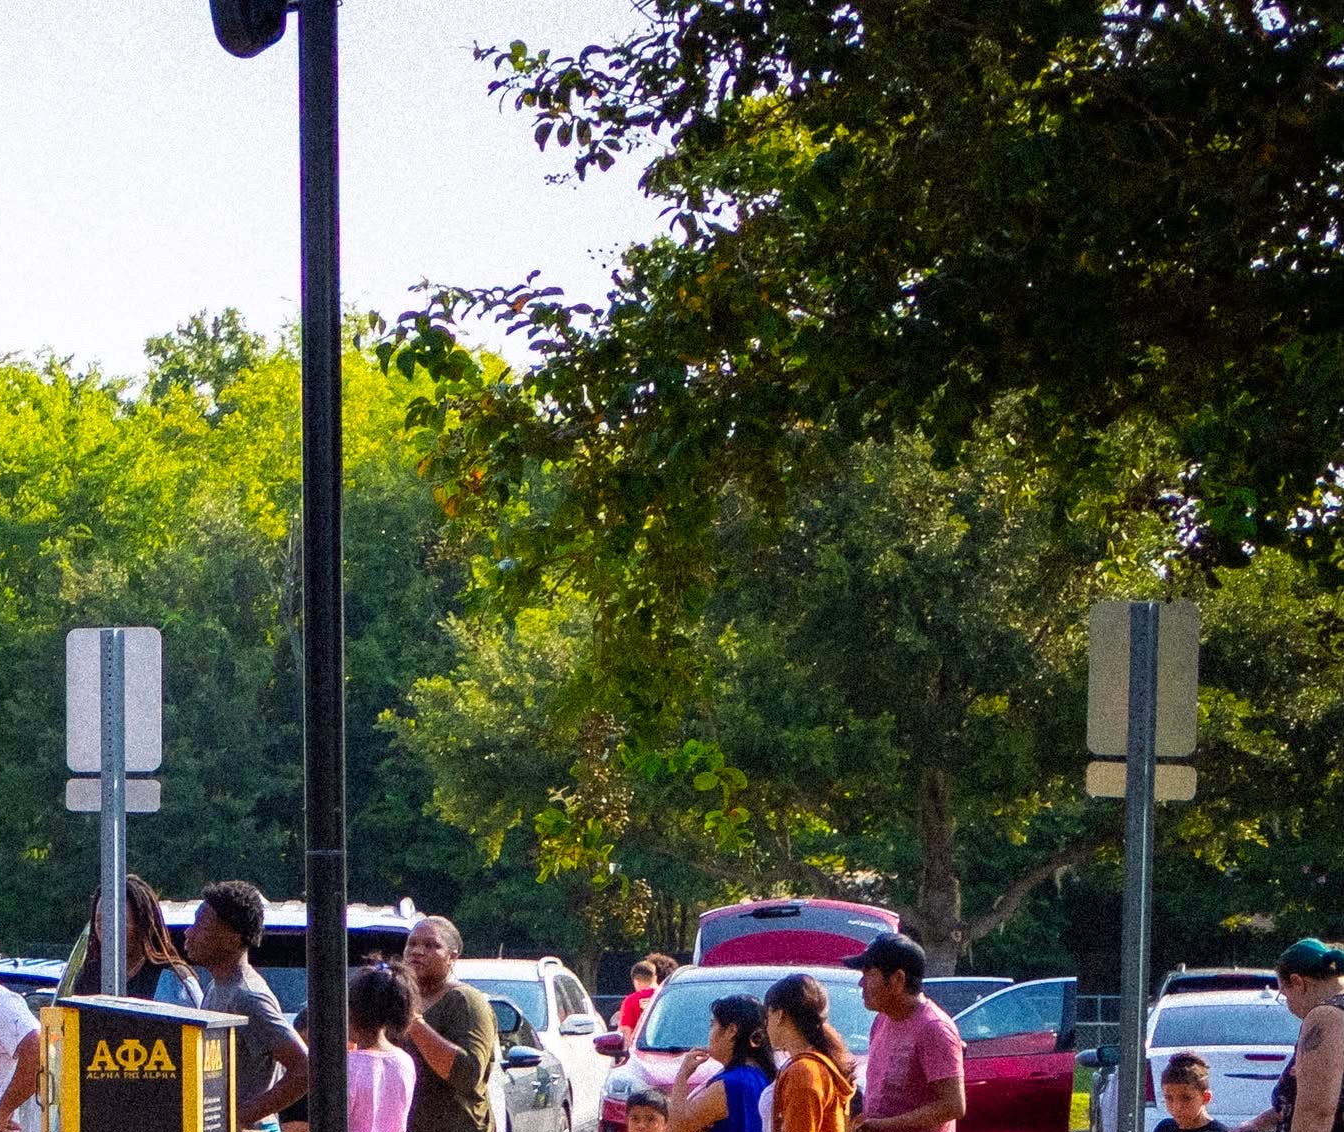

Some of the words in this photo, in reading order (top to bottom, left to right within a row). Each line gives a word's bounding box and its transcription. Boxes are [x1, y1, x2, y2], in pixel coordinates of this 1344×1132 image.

[86, 1071, 121, 1080] ALPHA
[123, 1071, 140, 1080] PHI
[142, 1071, 177, 1080] ALPHA
